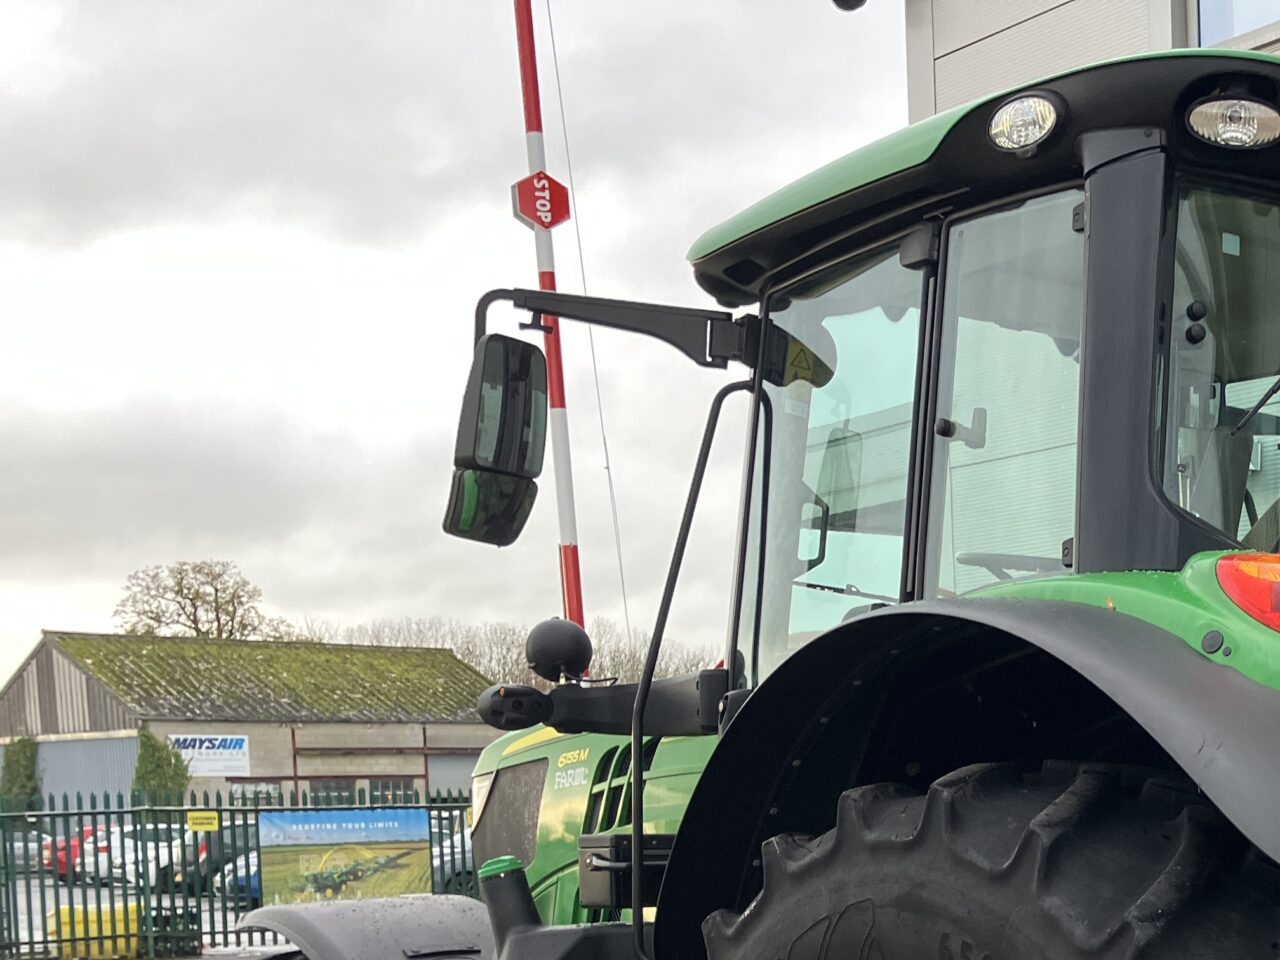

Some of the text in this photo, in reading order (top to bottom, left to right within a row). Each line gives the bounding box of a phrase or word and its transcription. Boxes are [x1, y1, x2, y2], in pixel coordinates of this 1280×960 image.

[533, 178, 551, 223] STOP
[172, 737, 245, 750] MAYSAIR
[342, 822, 365, 830] YOUR
[369, 821, 399, 829] LIMITS
